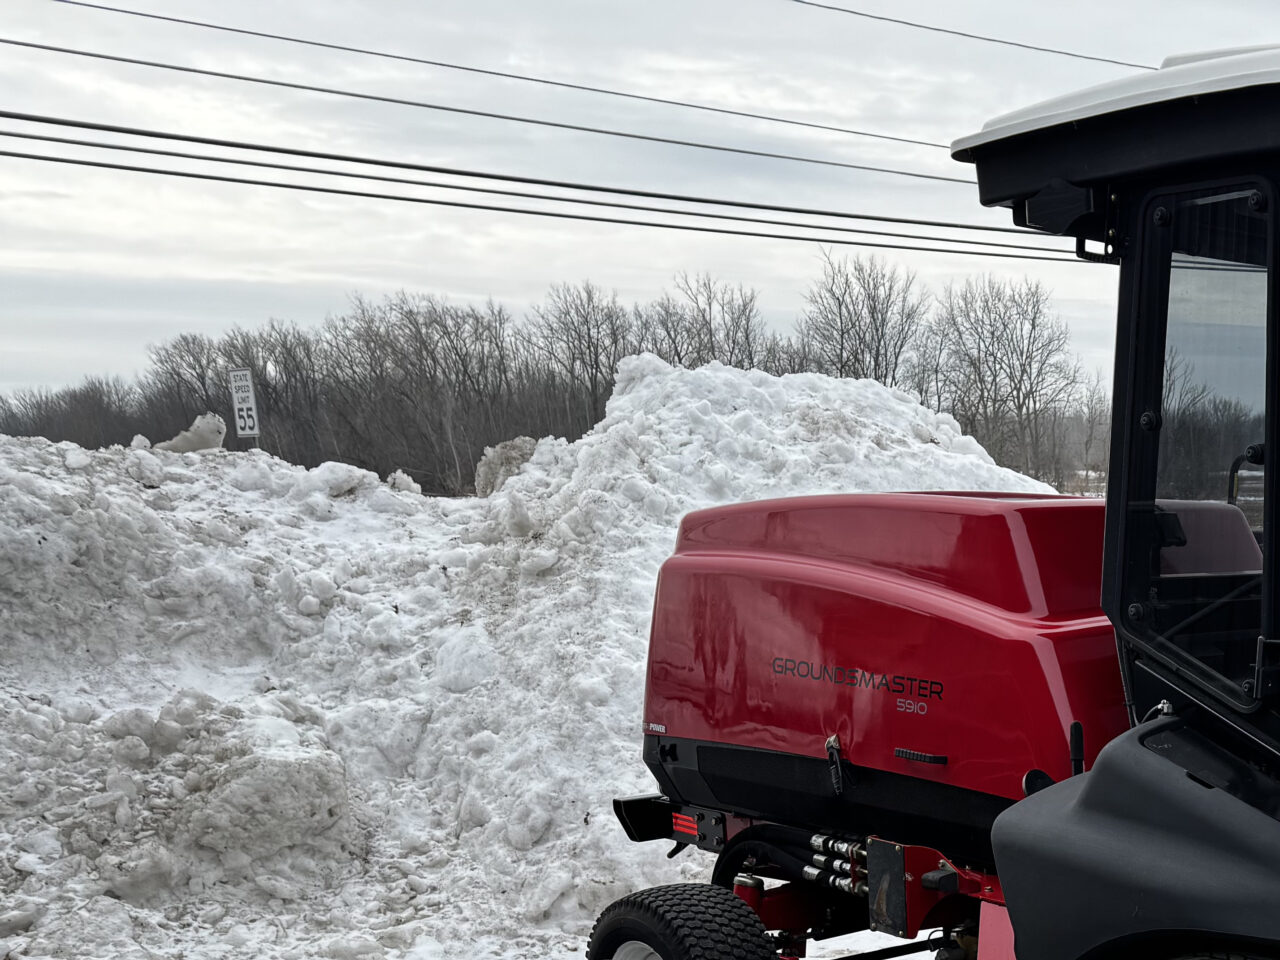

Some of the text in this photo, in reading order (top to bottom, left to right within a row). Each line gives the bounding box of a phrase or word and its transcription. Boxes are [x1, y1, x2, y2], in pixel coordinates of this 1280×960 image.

[233, 373, 249, 383] STATE
[234, 384, 250, 394] SPEED
[237, 395, 250, 405] LIMIT
[237, 406, 255, 431] 55
[772, 657, 944, 700] GROUNDSMASTER
